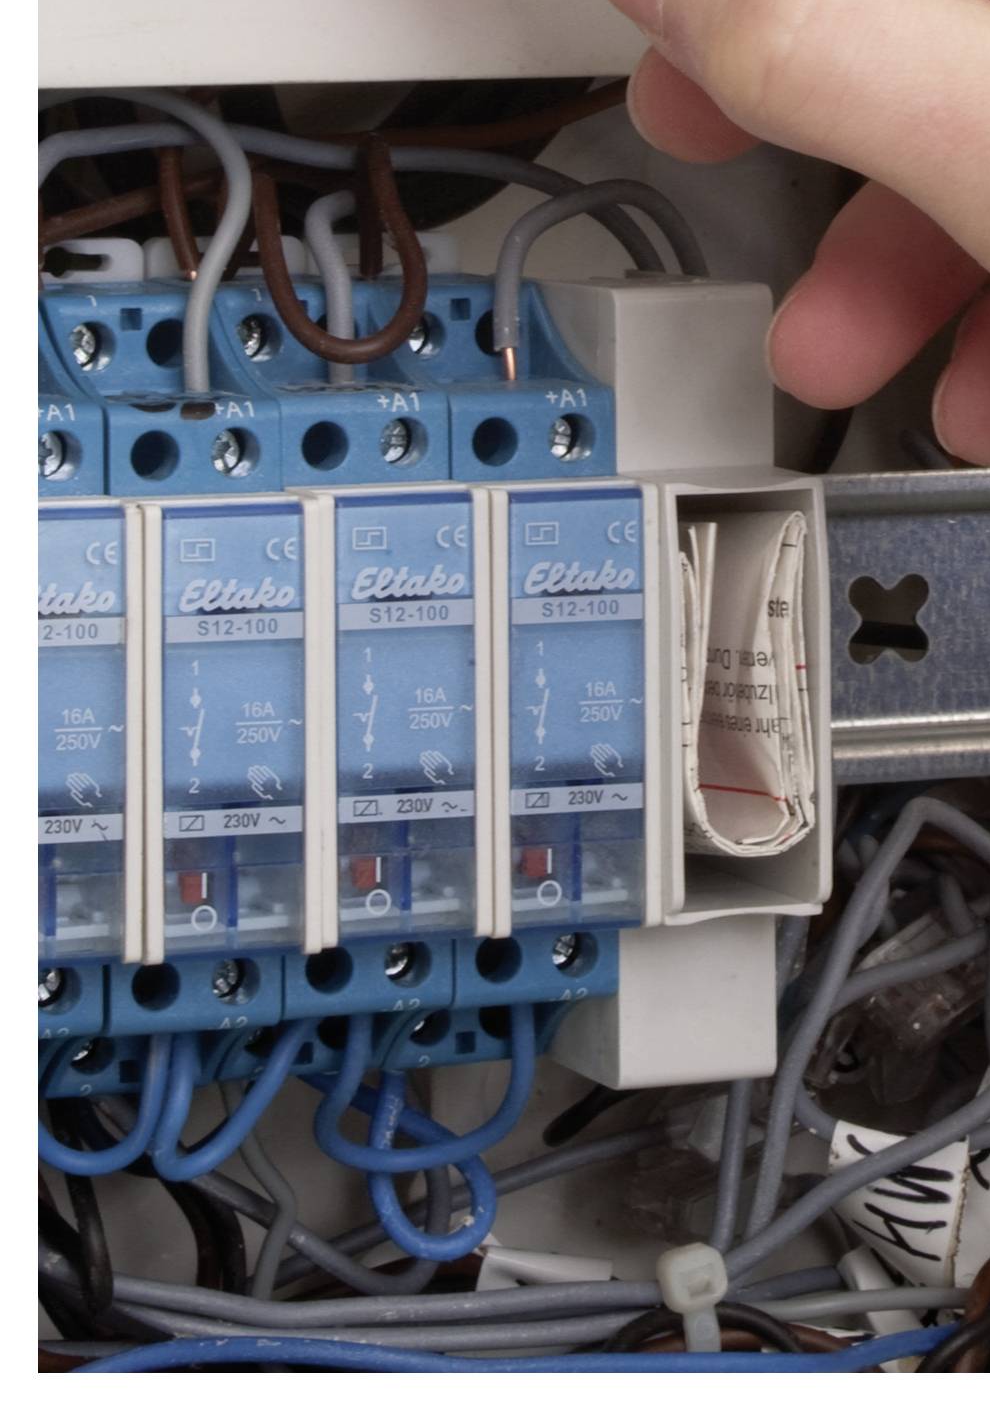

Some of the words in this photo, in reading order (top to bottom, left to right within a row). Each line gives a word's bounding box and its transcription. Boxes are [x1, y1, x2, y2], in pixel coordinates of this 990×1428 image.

[351, 564, 466, 601] Eltako
[523, 560, 636, 595] Eltako
[38, 581, 117, 616] tako
[179, 577, 296, 613] Eltako
[369, 605, 449, 624] S12-100
[541, 600, 620, 618] S12-100
[197, 618, 279, 637] S12-100
[415, 687, 447, 704] 16A
[585, 681, 617, 697] 16A
[61, 708, 96, 725] 16A
[241, 701, 276, 718] 16A
[580, 705, 623, 723] 250V
[409, 712, 452, 730] 250V
[55, 733, 102, 751] 250V
[236, 726, 284, 744] 250V
[362, 763, 374, 779] 2
[535, 756, 546, 772] 2
[188, 778, 200, 794] 2
[396, 798, 433, 814] 230V
[568, 790, 604, 806] 230V
[44, 819, 83, 834] 230V
[223, 813, 261, 830] 230V
